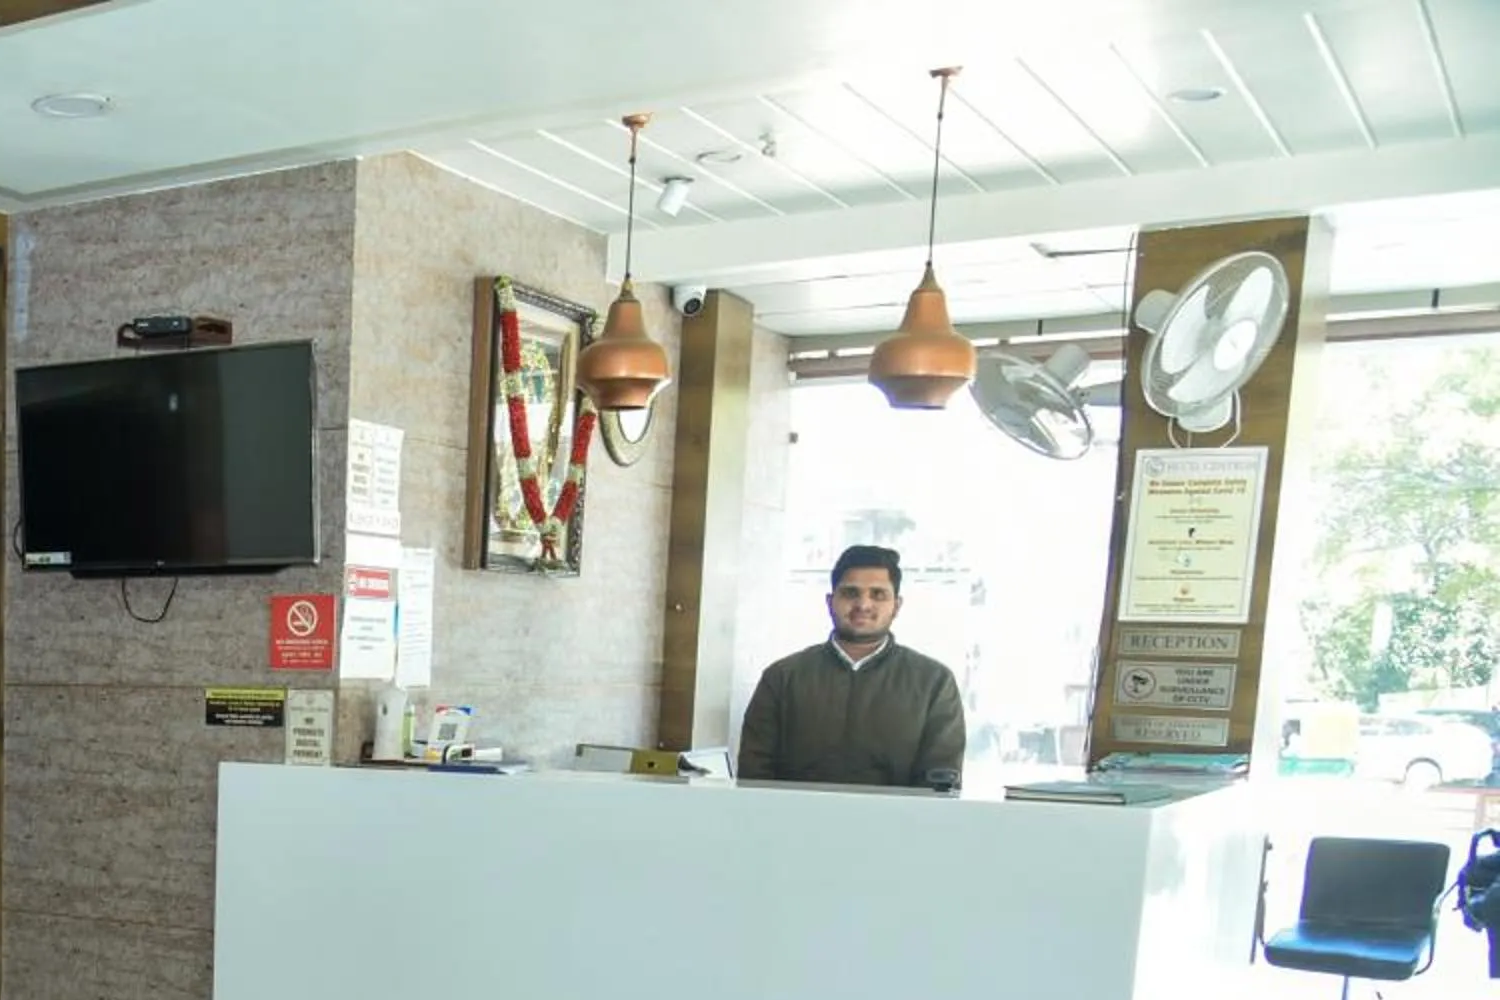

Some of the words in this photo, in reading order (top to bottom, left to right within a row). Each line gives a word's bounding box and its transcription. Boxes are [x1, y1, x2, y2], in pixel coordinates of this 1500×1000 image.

[1129, 634, 1228, 650] RECEPTION
[1196, 669, 1214, 677] ARE
[1159, 685, 1226, 696] SURVEILLANCE
[1187, 695, 1211, 704] CCTV
